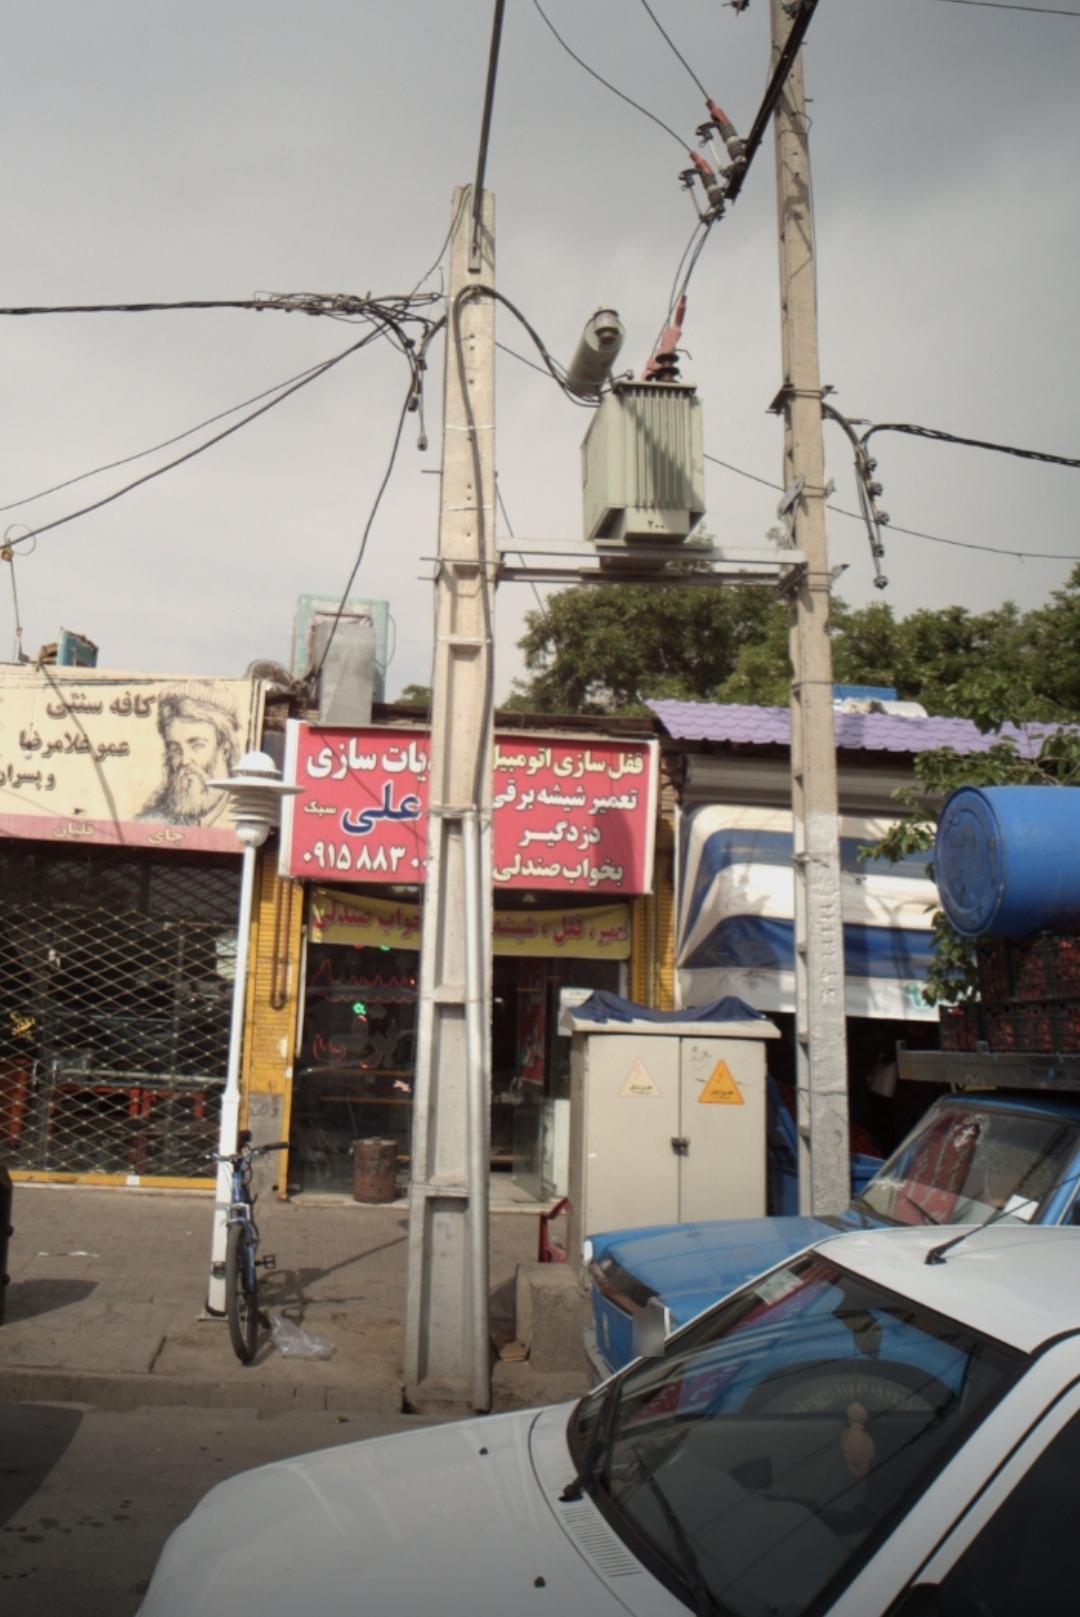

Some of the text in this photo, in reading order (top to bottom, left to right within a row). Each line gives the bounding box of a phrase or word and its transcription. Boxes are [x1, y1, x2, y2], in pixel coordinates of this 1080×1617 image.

[46, 691, 157, 719] کافه سنتی
[94, 740, 130, 762] عمو
[306, 738, 376, 779] سازی
[553, 751, 605, 777] سازی
[607, 752, 644, 779] قفل
[45, 773, 56, 791] و
[341, 780, 423, 835] علی
[493, 780, 637, 815] تعمیر شیشه برقی
[518, 821, 601, 850] دزدگیر
[493, 854, 624, 886] بخواب صندلی
